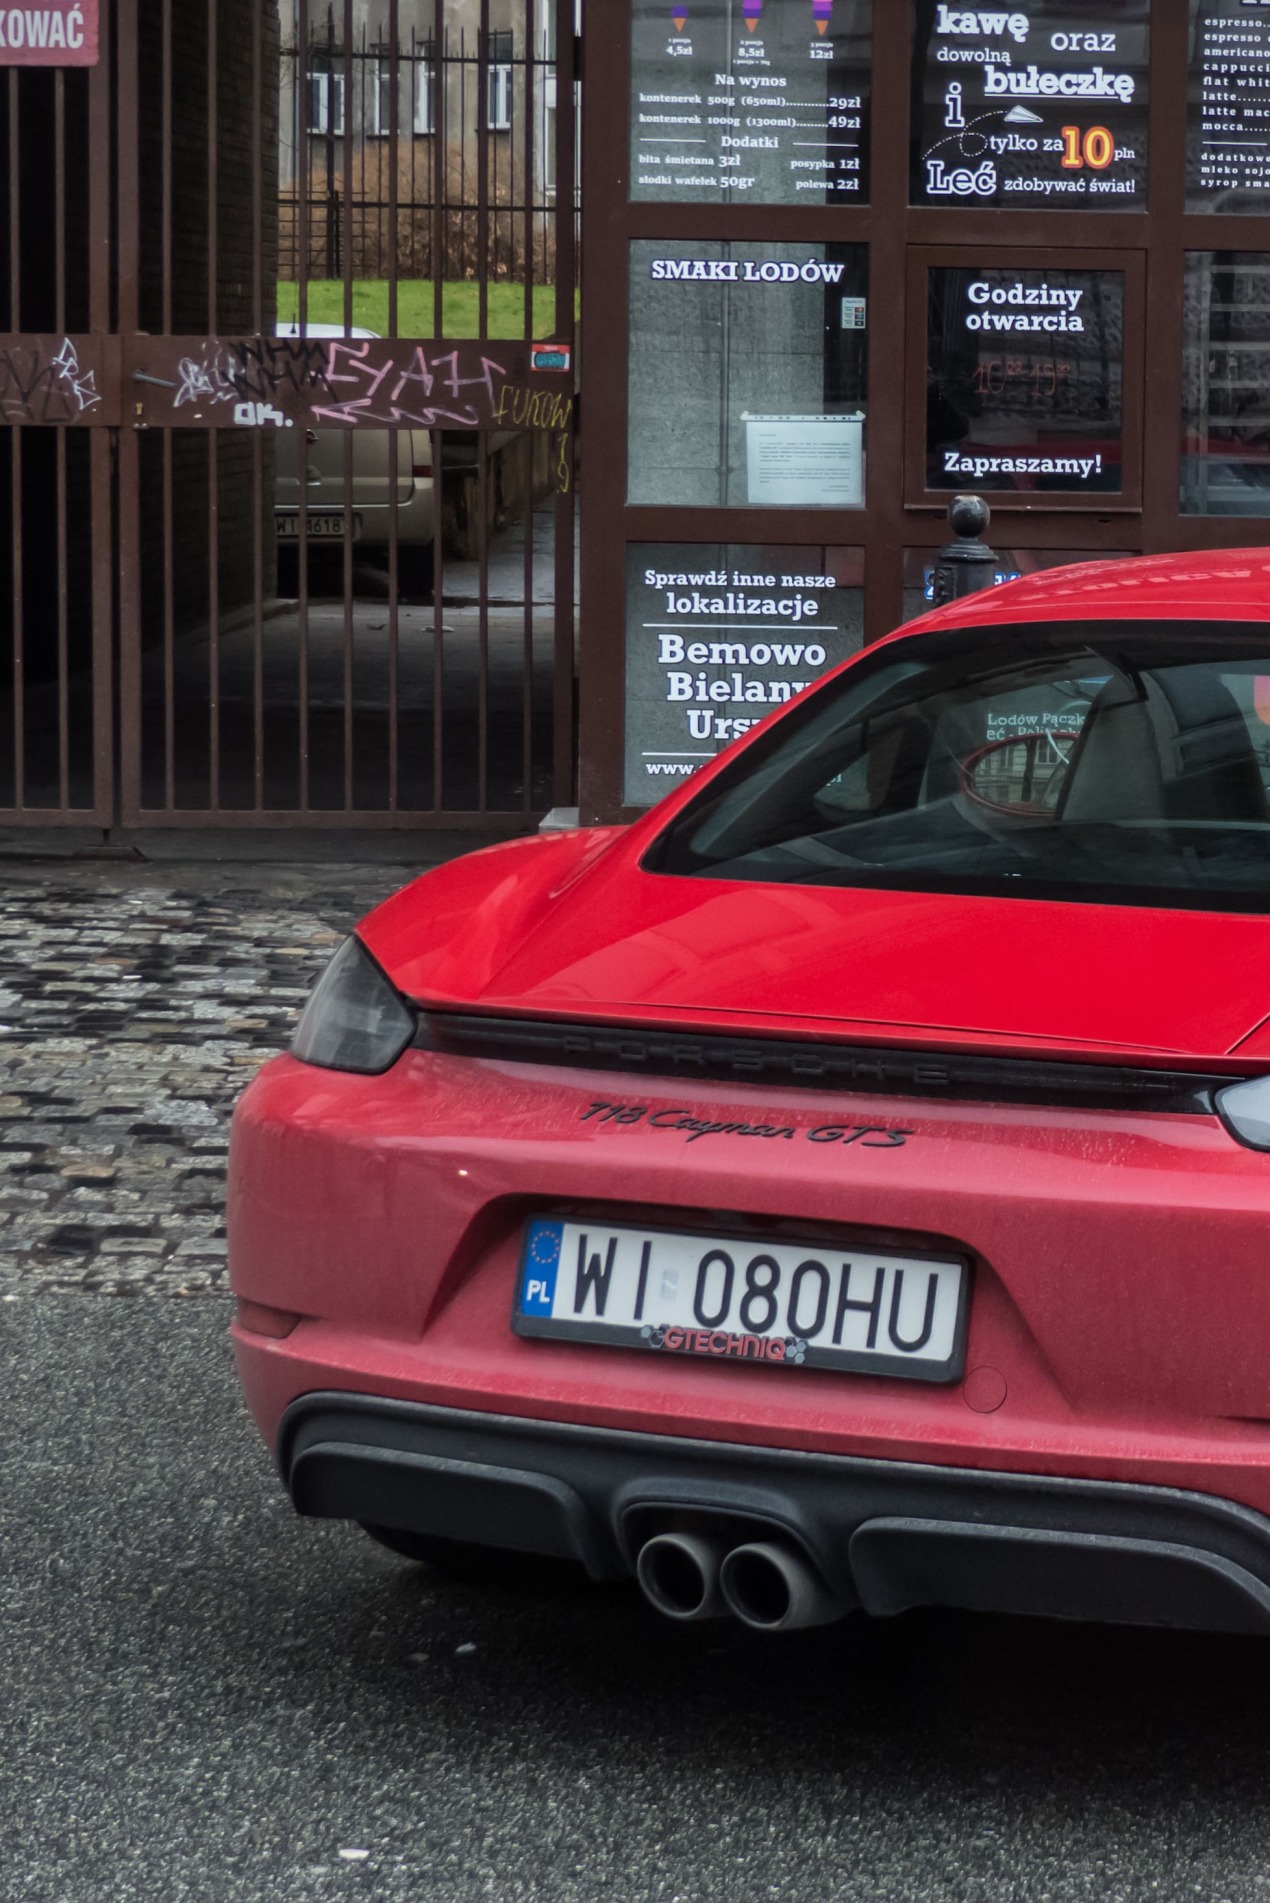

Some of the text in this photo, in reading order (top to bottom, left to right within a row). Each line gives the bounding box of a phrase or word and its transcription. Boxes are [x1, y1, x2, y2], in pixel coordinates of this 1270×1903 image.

[937, 5, 1029, 42] kawę
[1204, 18, 1263, 28] espresso
[1051, 32, 1116, 51] oraz
[1204, 33, 1261, 43] espresso
[738, 48, 764, 58] 8,5zł
[810, 50, 834, 59] 12zł
[937, 47, 1011, 66] dowolną
[1204, 48, 1270, 57] americano
[714, 74, 787, 88] Na wynos
[984, 65, 1135, 103] bułeczkę
[1203, 76, 1229, 86] flat
[640, 93, 702, 104] kontenerek
[708, 96, 735, 106] 500g
[829, 96, 861, 109] 29zł
[945, 82, 965, 127] i
[1203, 91, 1237, 101] latte
[1203, 106, 1237, 116] latte
[640, 113, 701, 124] kontenerek
[708, 117, 740, 126] 1000g
[828, 116, 860, 128] 49zł
[1202, 123, 1244, 131] mocca
[721, 136, 779, 148] Dodatki
[990, 126, 1136, 169] tylko za 10 pln
[638, 154, 741, 167] bita śmietana 3zł
[790, 158, 860, 170] posypka 1zł
[926, 161, 1136, 195] Leć zdobywać świat!
[1201, 166, 1238, 174] mleko
[638, 175, 755, 189] słodki wafelek 50gr
[796, 178, 859, 190] polewa 2zł
[1200, 179, 1238, 188] syrop
[652, 259, 845, 283] SMAKI LODÓW
[968, 282, 1083, 310] Godziny
[966, 310, 1084, 332] otwarcia
[945, 452, 1102, 478] Zapraszamy!
[645, 570, 836, 589] Sprawdź inne nasze
[666, 592, 818, 621] lokalizacje
[658, 634, 826, 666] Bemowo
[687, 709, 761, 740] Urs
[987, 713, 1039, 726] Lodów
[564, 1035, 952, 1086] PORSCHE
[580, 1102, 916, 1148] 718 Cayman GTS
[526, 1280, 550, 1303] PL
[573, 1234, 938, 1352] WI 080HU
[664, 1326, 786, 1362] GTECHNIQ
